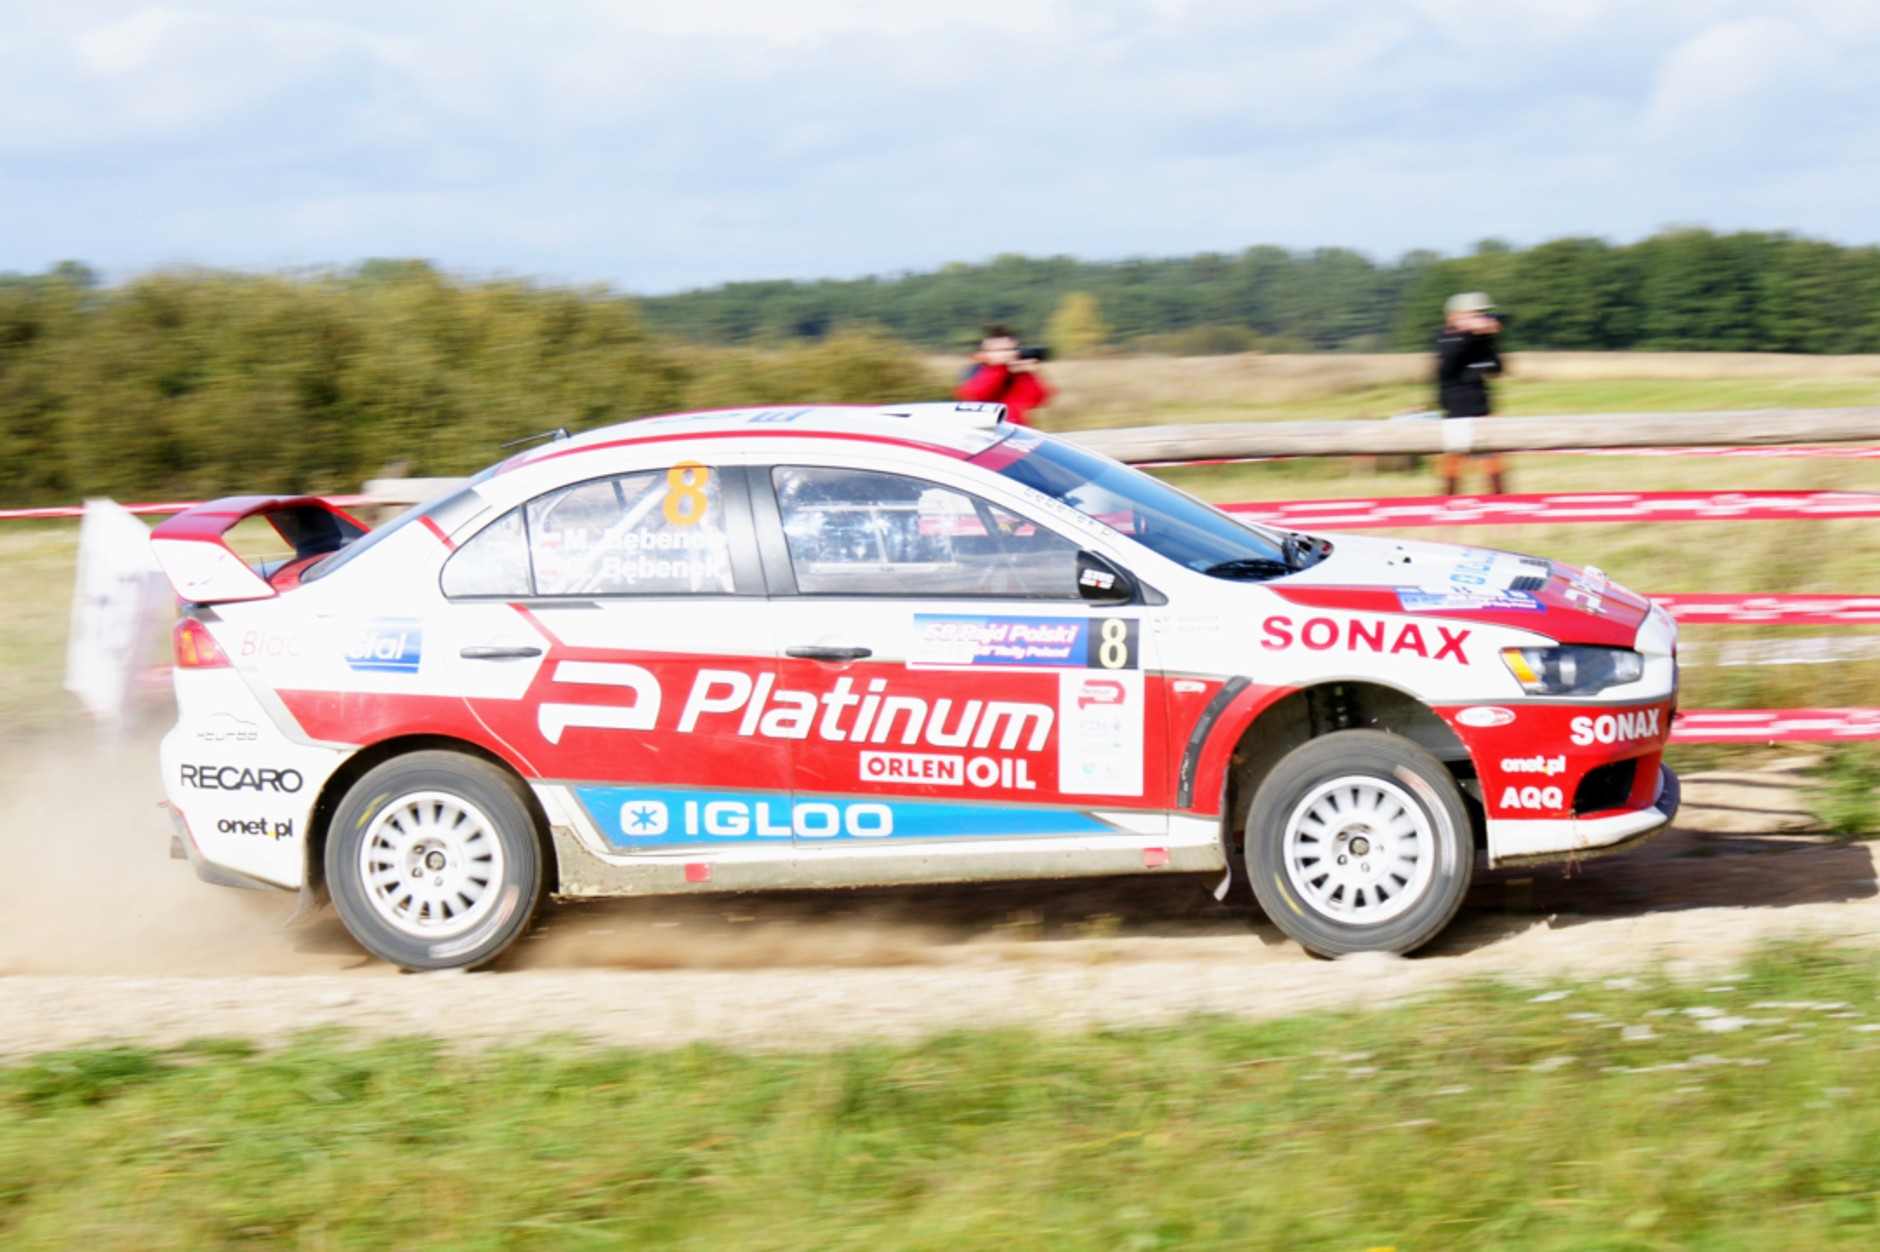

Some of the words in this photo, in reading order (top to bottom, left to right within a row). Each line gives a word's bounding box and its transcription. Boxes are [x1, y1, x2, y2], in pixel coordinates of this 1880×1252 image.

[662, 460, 710, 526] 8
[1099, 618, 1128, 669] 8
[1260, 615, 1473, 666] SONAX
[676, 668, 1055, 752] Platinum
[1570, 708, 1660, 746] SONAX
[180, 763, 304, 793] RECARO
[867, 755, 956, 782] ORLEN
[966, 755, 1036, 790] OIL
[1500, 755, 1567, 776] onet.pl
[1500, 786, 1563, 810] AQQ
[217, 817, 294, 840] onet.pl
[685, 800, 894, 839] IGLOO
